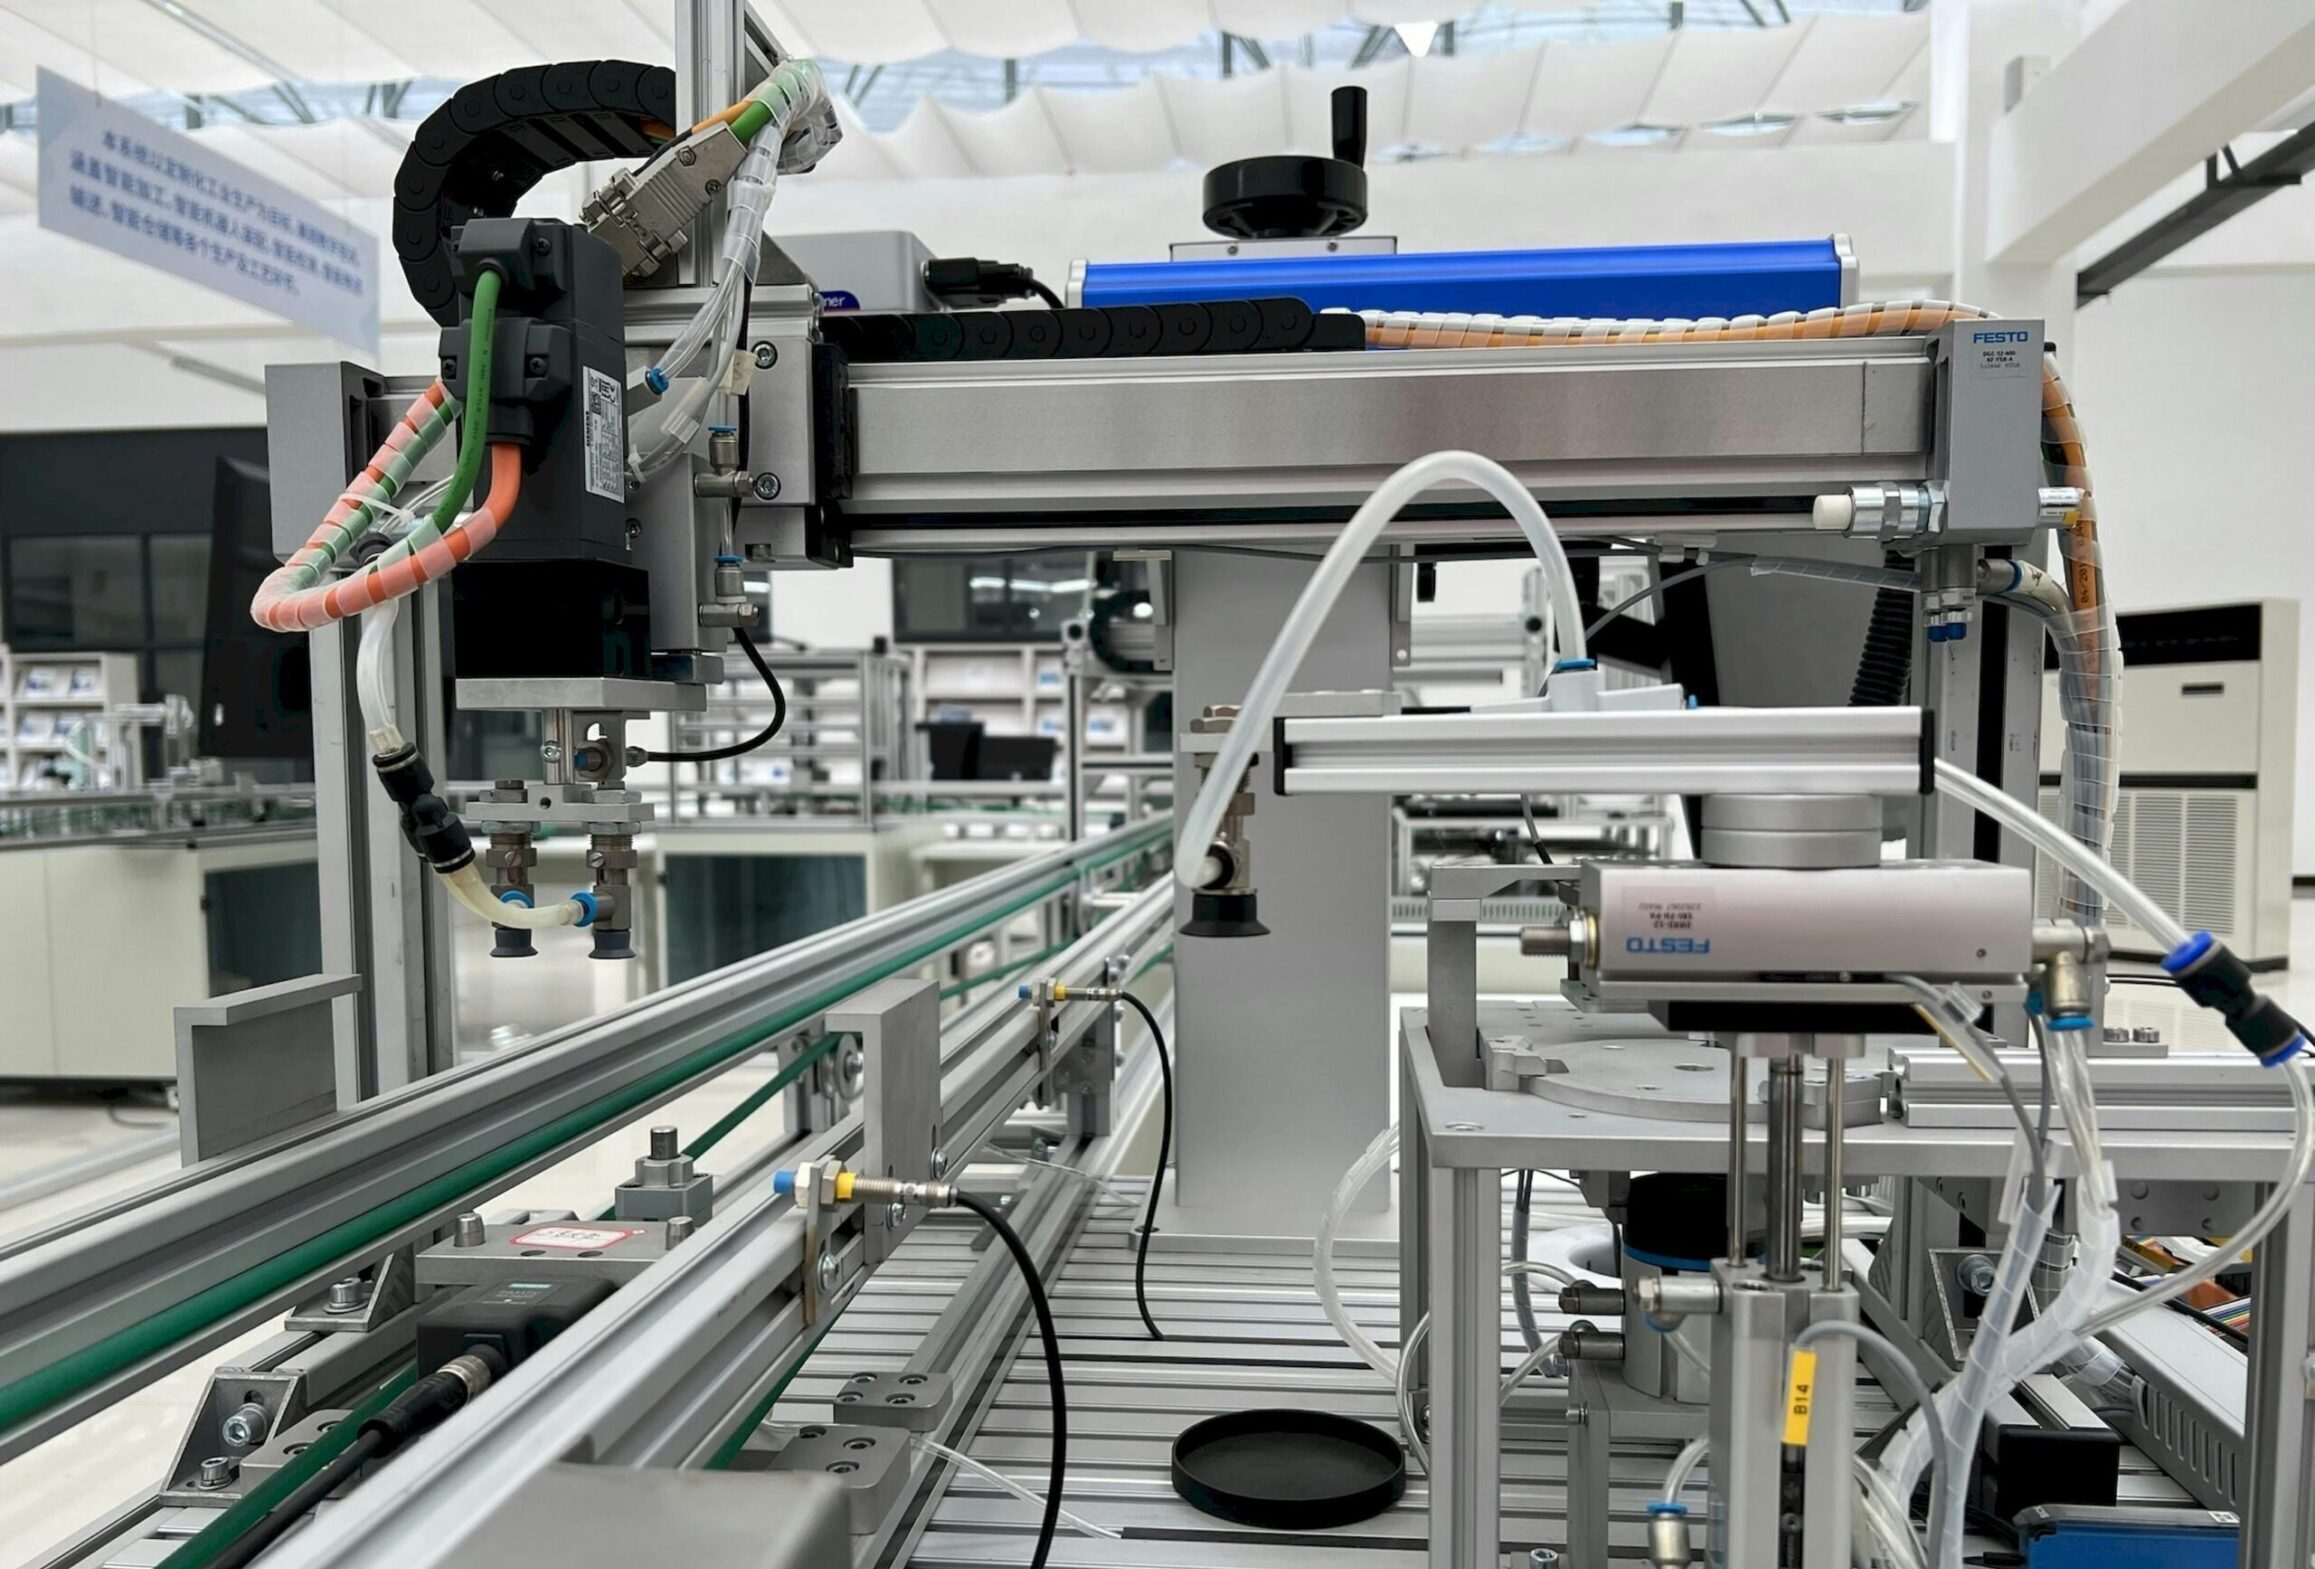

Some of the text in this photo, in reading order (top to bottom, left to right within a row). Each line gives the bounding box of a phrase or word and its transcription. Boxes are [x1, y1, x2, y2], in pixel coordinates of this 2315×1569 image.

[1973, 331, 2029, 344] FESTO
[1625, 936, 1711, 954] FESTO
[1793, 1384, 1810, 1415] B14
